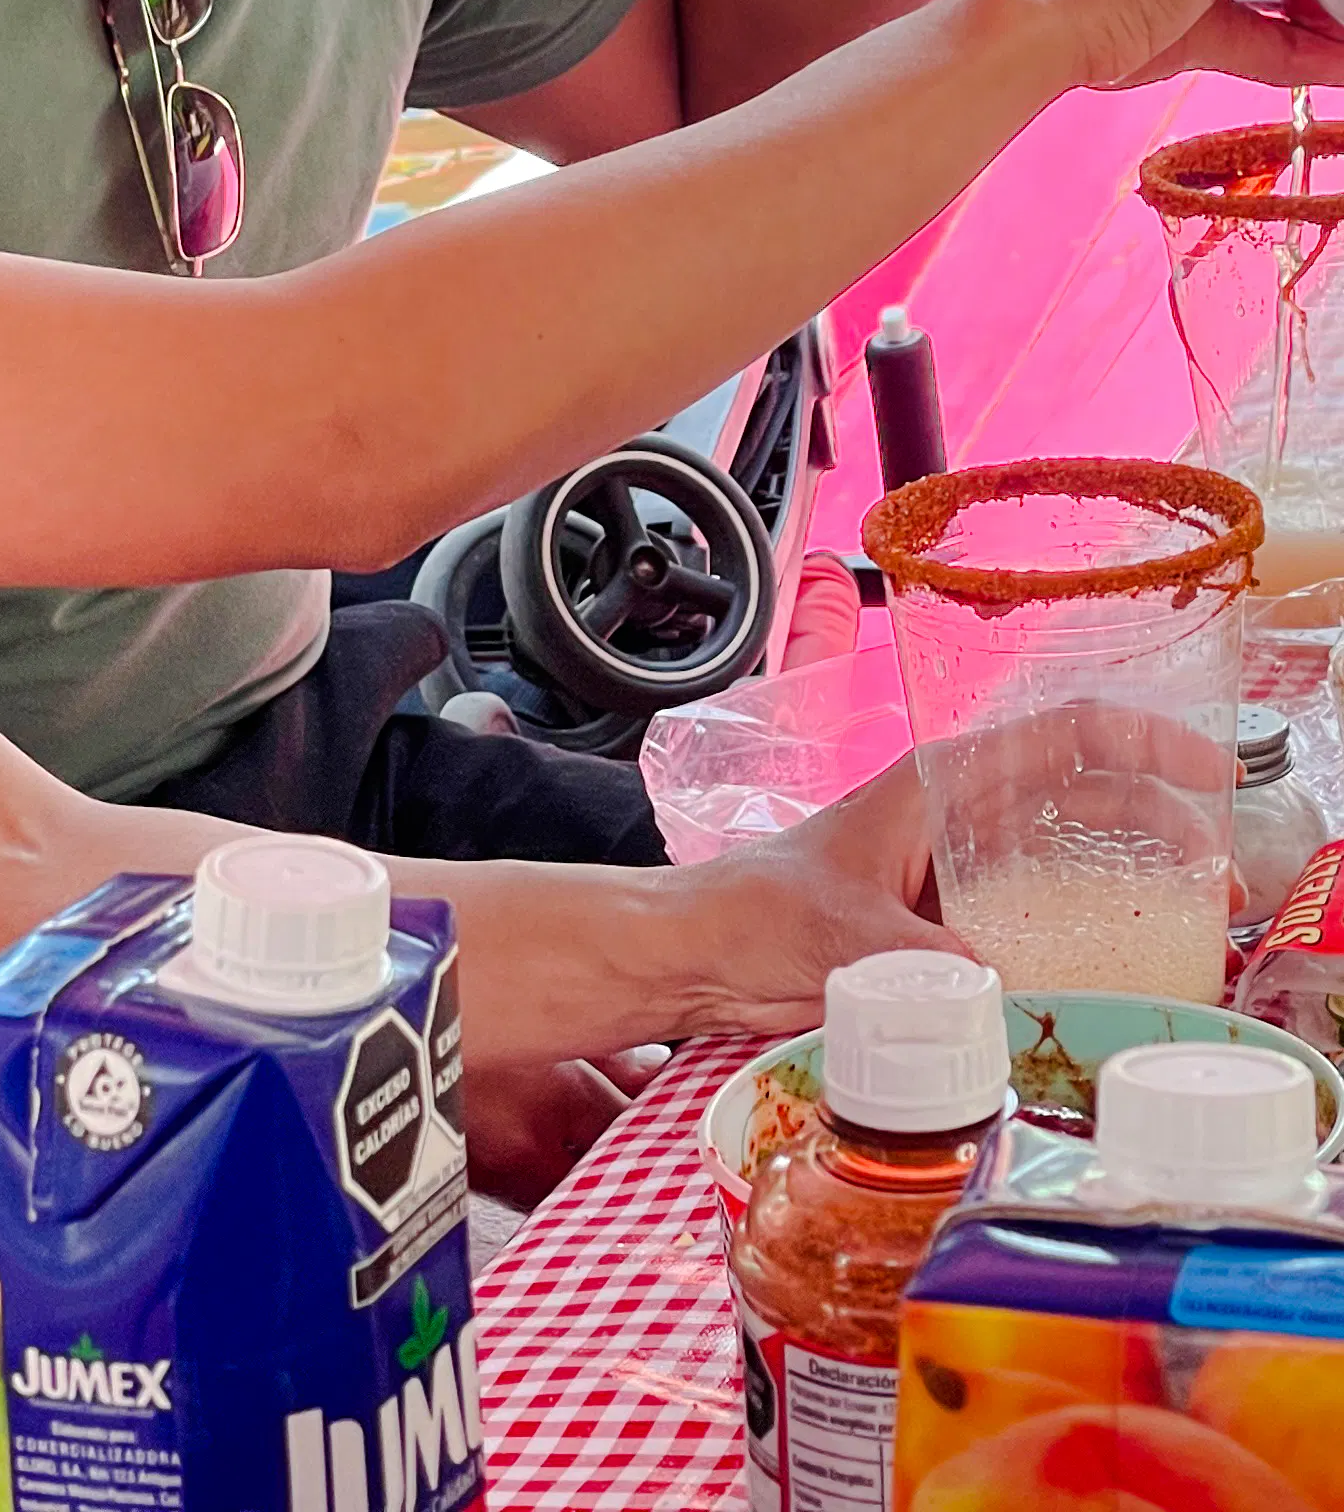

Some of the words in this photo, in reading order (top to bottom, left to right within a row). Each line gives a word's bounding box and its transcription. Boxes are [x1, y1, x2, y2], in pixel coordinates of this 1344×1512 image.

[1265, 851, 1344, 949] SOLELY
[357, 1067, 412, 1127] EXCESO
[11, 1345, 173, 1411] JUMEX
